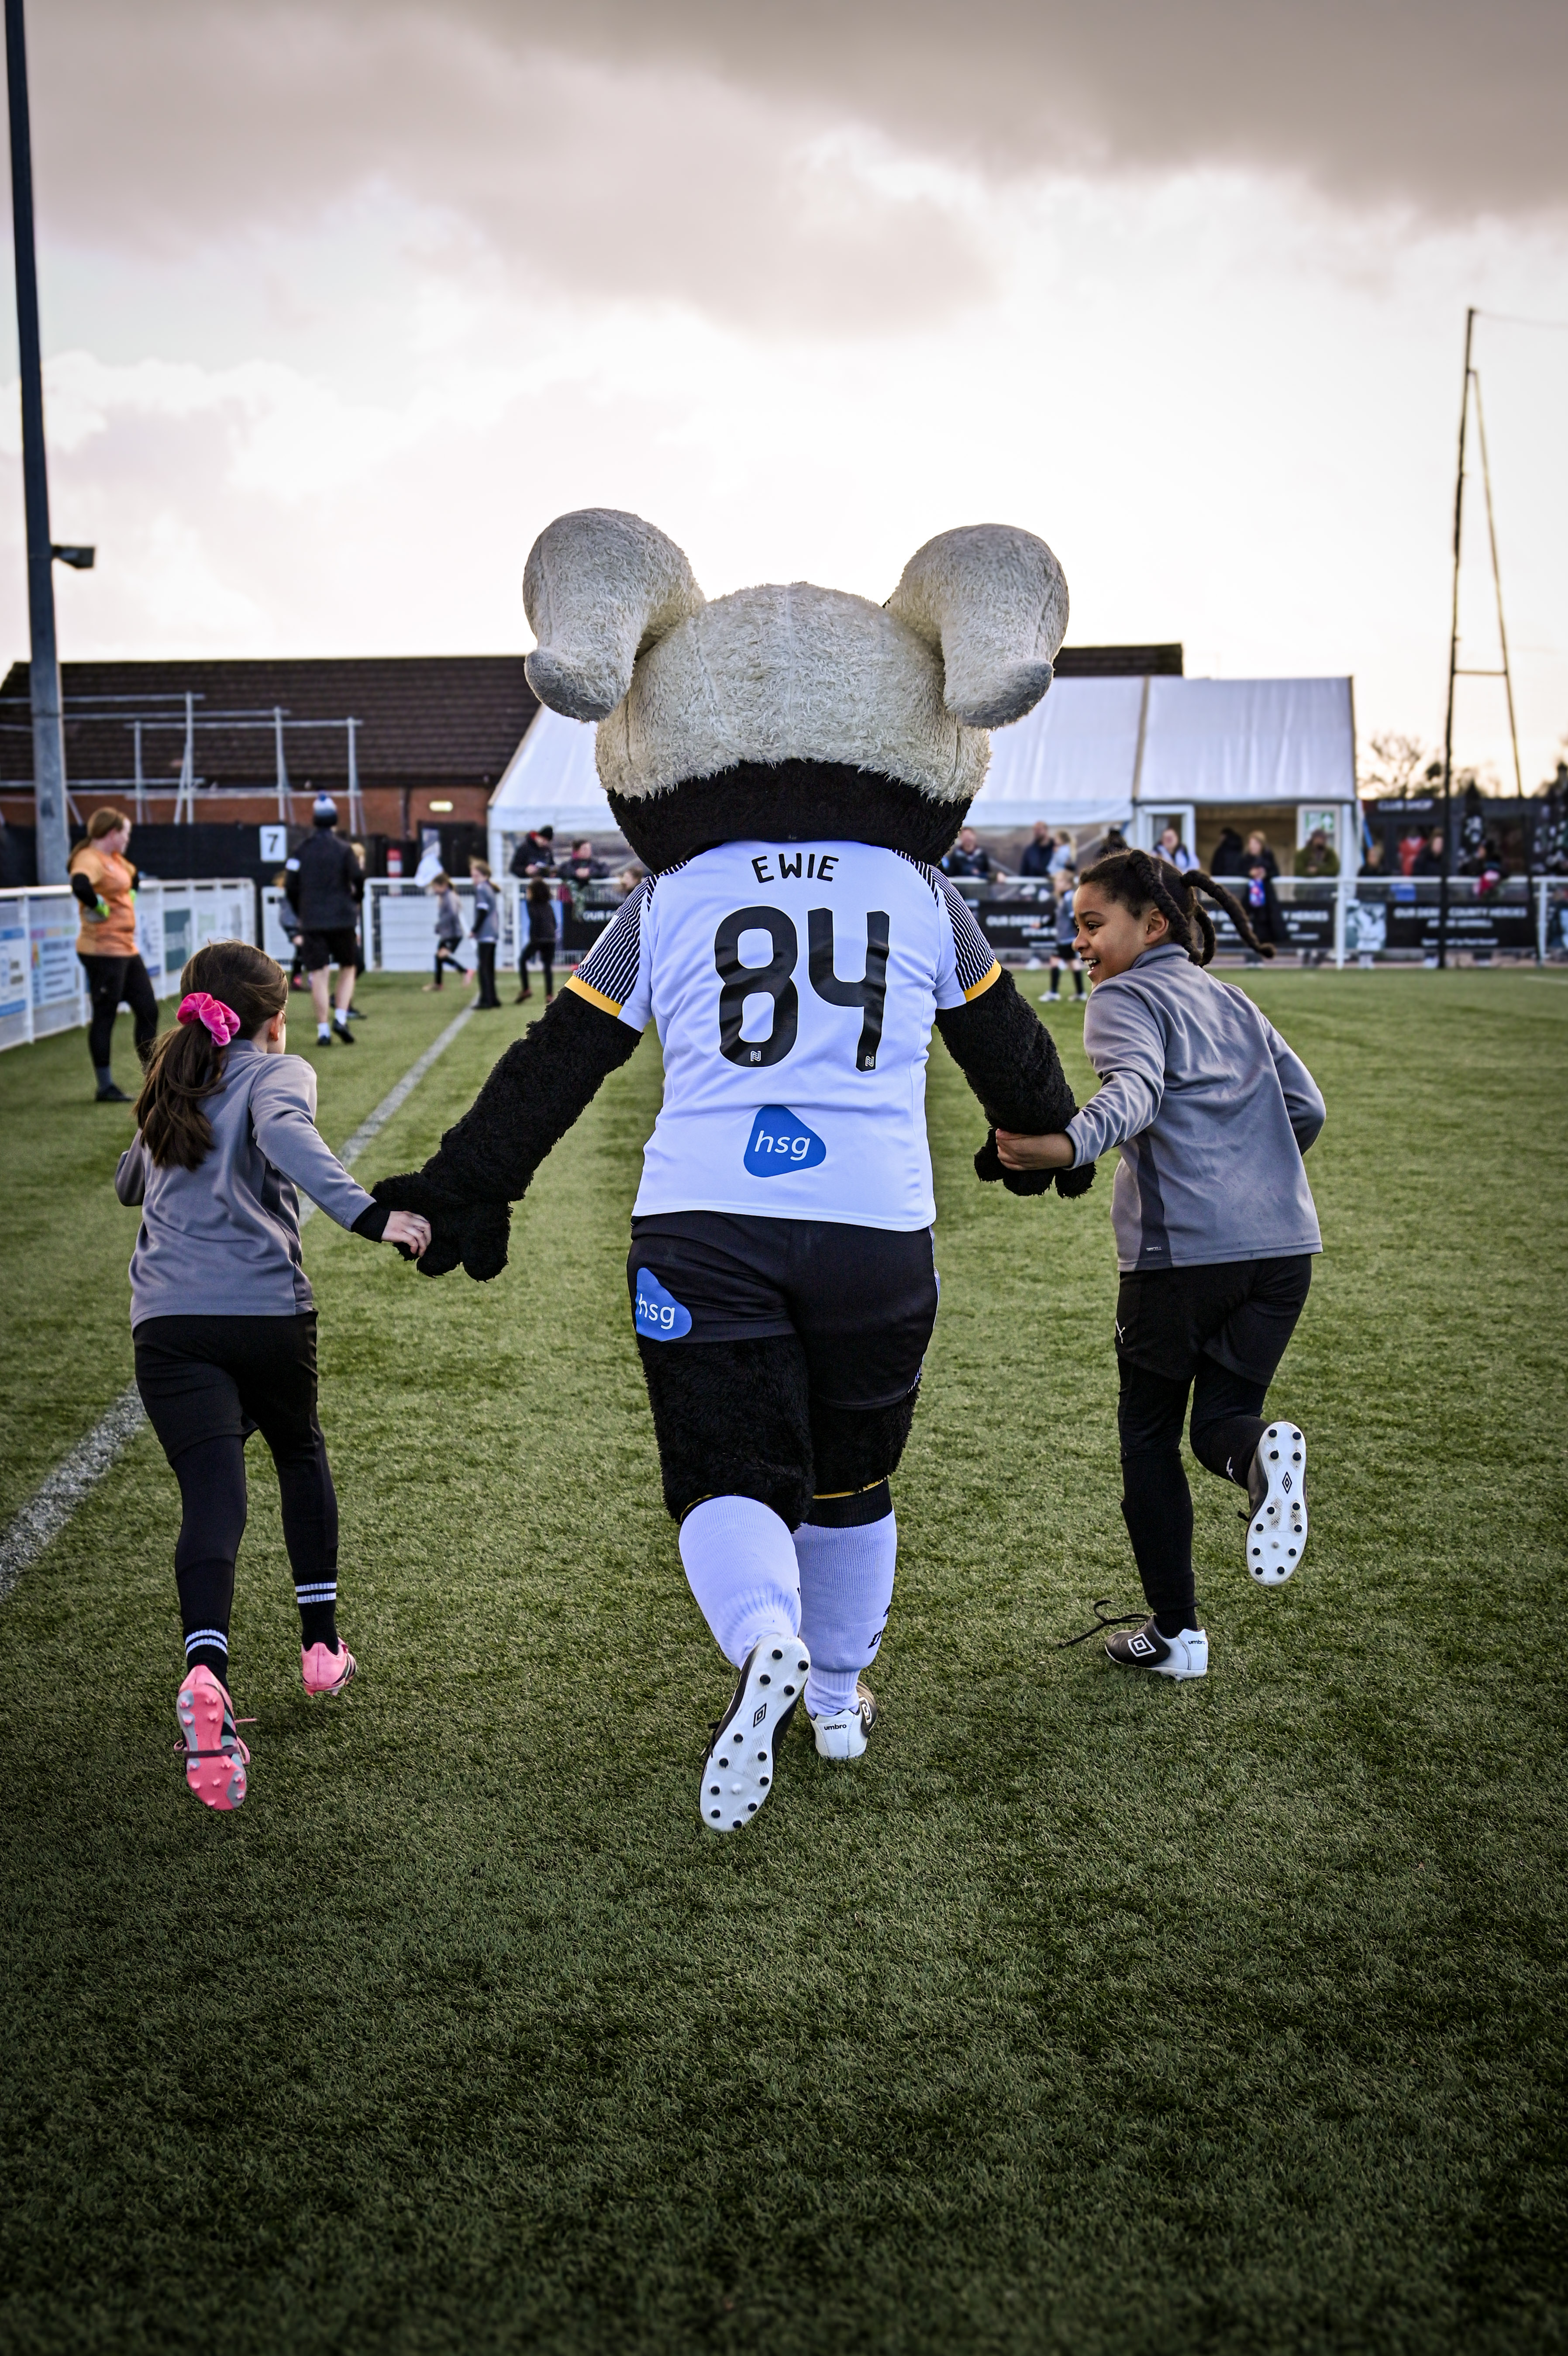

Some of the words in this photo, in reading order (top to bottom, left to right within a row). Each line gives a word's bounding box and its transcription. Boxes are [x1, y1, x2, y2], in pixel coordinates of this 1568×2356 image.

[267, 834, 278, 853] 7
[751, 853, 839, 883] EWIE
[714, 906, 890, 1072] 84
[754, 1130, 810, 1161] hsg
[638, 1293, 675, 1330] hsg
